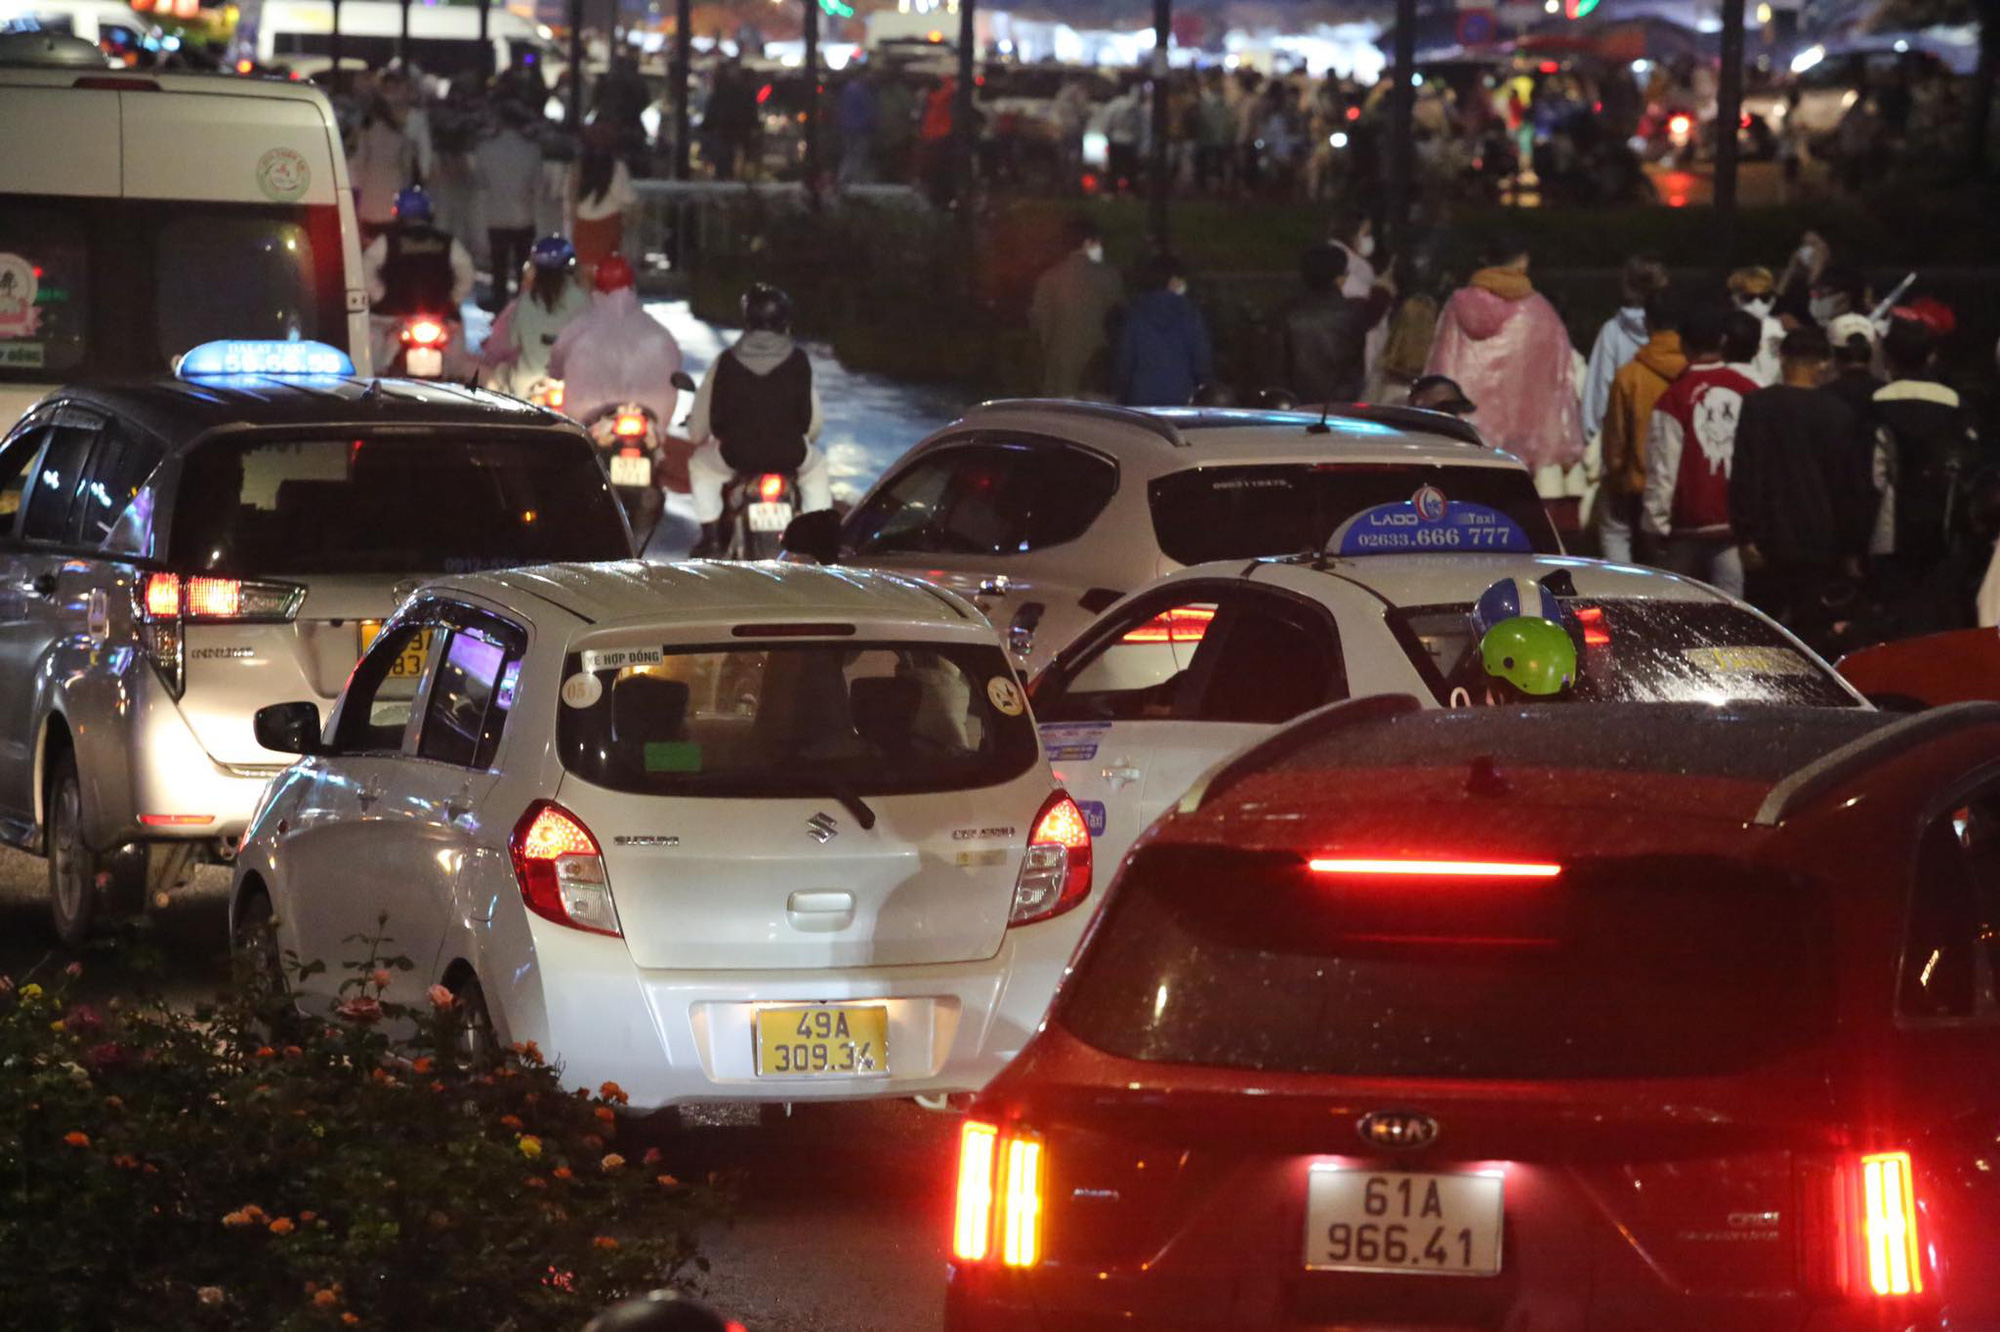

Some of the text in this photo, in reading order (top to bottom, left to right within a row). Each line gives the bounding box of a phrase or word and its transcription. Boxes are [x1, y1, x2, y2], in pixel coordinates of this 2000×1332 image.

[1370, 514, 1418, 525] LADO
[1468, 527, 1510, 545] 777
[797, 1012, 850, 1038] 49A
[775, 1043, 875, 1071] 309.34
[1365, 1177, 1442, 1217] 61A
[1328, 1223, 1473, 1266] 966.41
